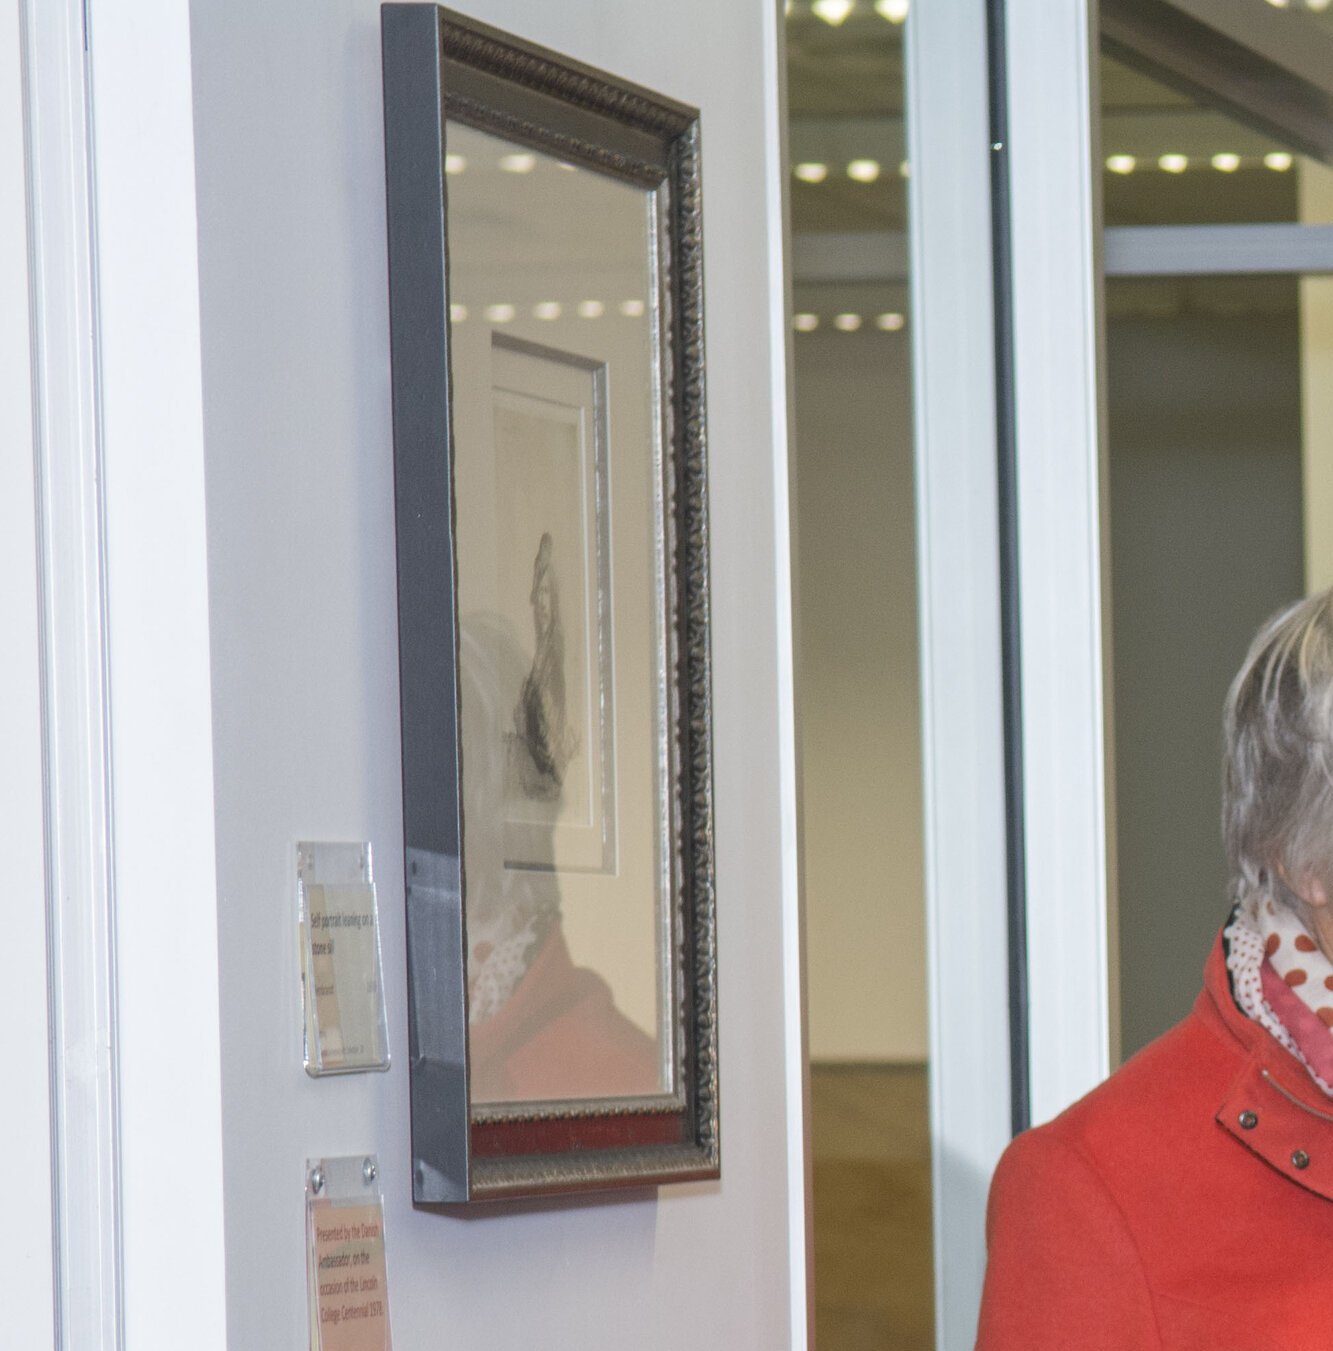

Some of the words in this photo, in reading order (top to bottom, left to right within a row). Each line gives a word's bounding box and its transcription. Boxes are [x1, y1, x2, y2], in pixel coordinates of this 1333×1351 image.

[322, 912, 341, 930] portrait
[316, 1226, 343, 1242] Presented
[344, 1226, 351, 1242] by
[352, 1224, 360, 1239] the
[361, 1223, 379, 1238] Danish
[353, 1253, 360, 1266] on
[361, 1249, 370, 1265] the
[320, 1280, 343, 1296] occasion
[350, 1278, 359, 1292] the
[360, 1276, 378, 1292] Lincoln
[321, 1306, 341, 1325] College
[341, 1302, 369, 1320] Centennial
